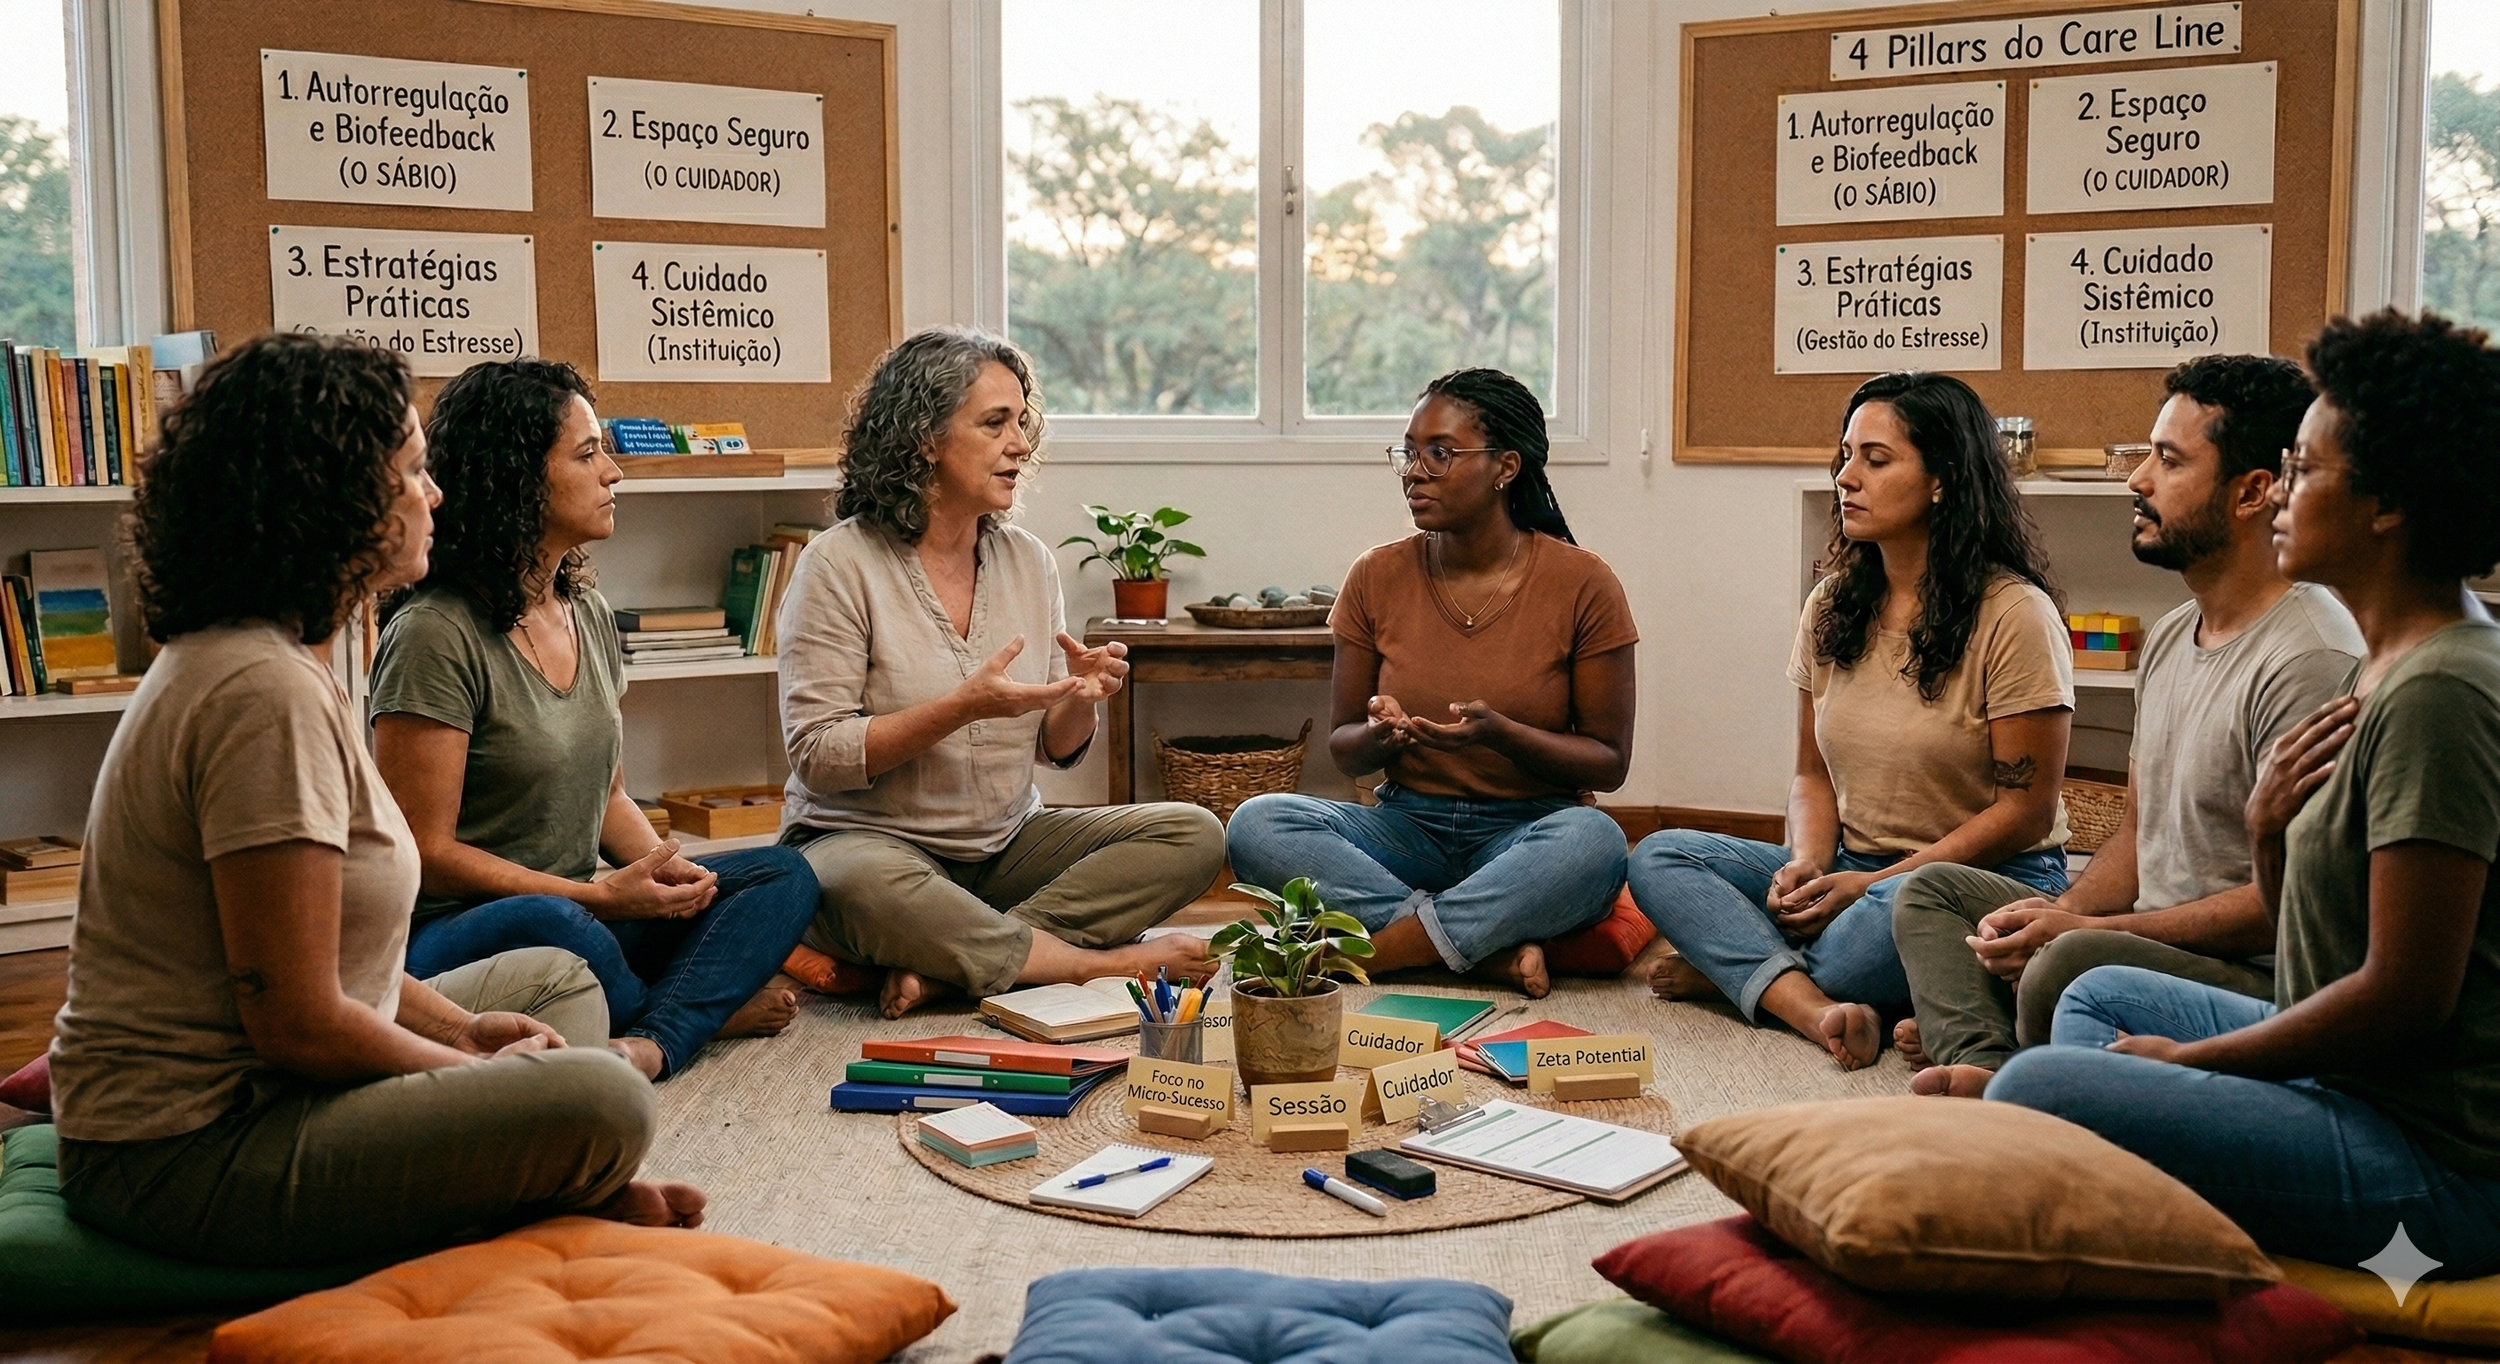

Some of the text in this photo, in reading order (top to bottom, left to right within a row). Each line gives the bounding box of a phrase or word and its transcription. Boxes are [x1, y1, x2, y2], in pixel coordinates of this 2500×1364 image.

[1848, 14, 2224, 71] 4 Pillars do Care Line
[278, 70, 508, 119] 1. Autorregulação
[2077, 89, 2206, 123] 2. Espaço
[309, 113, 495, 151] e Biofeedback
[602, 110, 809, 156] 2. Espaço Seguro
[1787, 104, 1993, 140] 1. Autorregulação
[1811, 137, 1977, 173] e Biofeedback
[2106, 126, 2199, 160] Seguro
[339, 156, 456, 194] (O SÁBIO)
[644, 161, 780, 197] (O CUIDADOR)
[2083, 160, 2229, 197] (O CUIDADOR)
[1833, 176, 1935, 210] (O SÁBIO)
[287, 245, 497, 290] 3. Estratégias
[1797, 254, 1972, 290] 3. Estratégias
[2070, 243, 2213, 275] 4. Cuidado
[630, 260, 767, 292] 4. Cuidado
[345, 282, 470, 319] Práticas
[651, 297, 773, 328] Sistêmico
[1836, 289, 1942, 318] Práticas
[2083, 282, 2213, 311] Sistêmico
[388, 329, 415, 353] do
[422, 328, 523, 360] Estresse)
[1796, 323, 1988, 354] (Gestão do Estresse)
[2080, 316, 2218, 348] (Instituição)
[647, 334, 780, 367] (Instituição)
[1347, 1030, 1423, 1053] Cuidador
[1535, 1046, 1645, 1067] Zeta Potential
[1151, 1070, 1205, 1090] Foco no
[1382, 1069, 1453, 1098] Cuidador
[1127, 1084, 1224, 1110] Micro-Sucesso
[1269, 1094, 1346, 1116] Sessão
